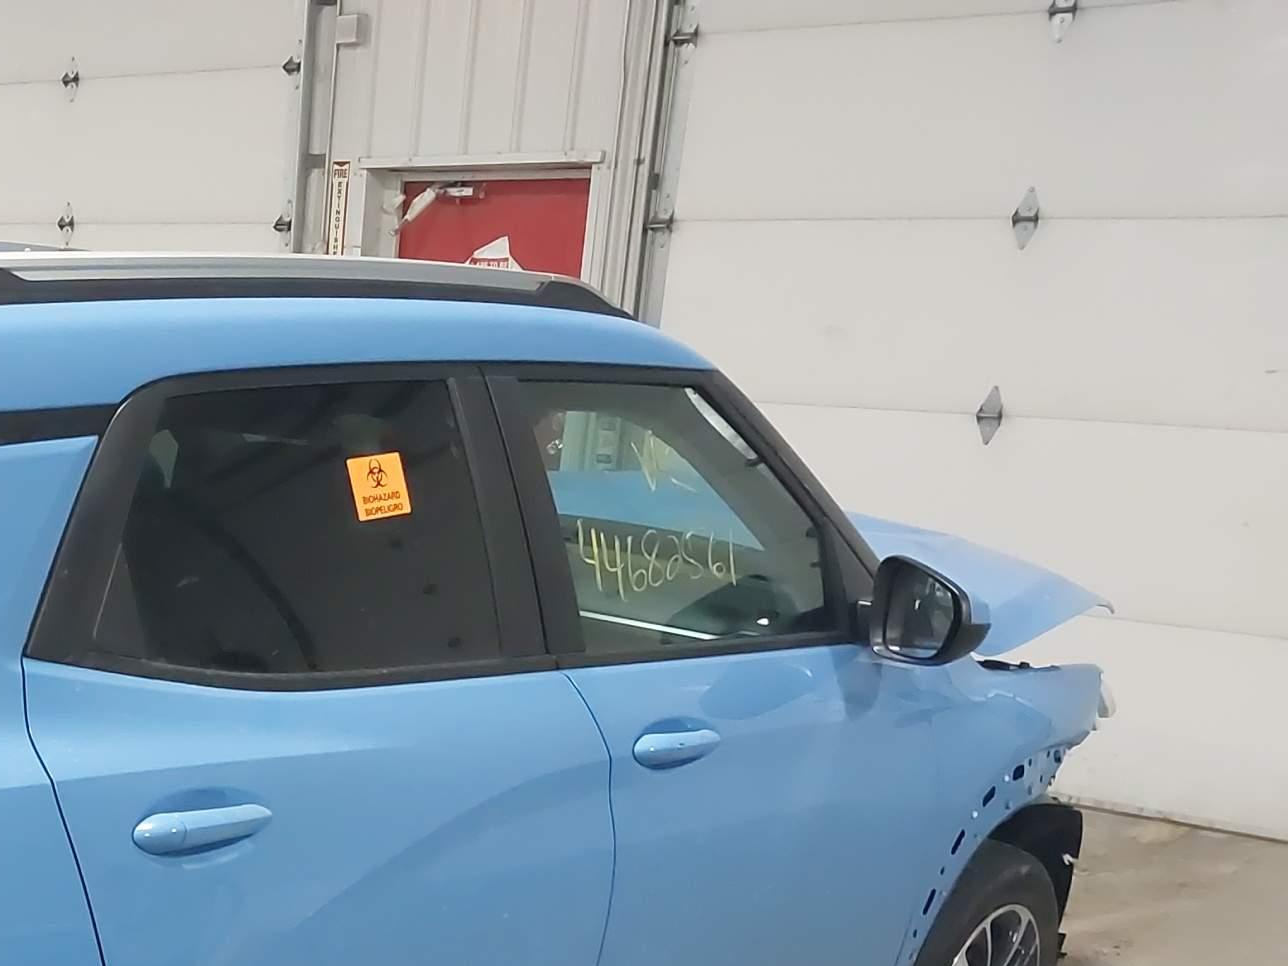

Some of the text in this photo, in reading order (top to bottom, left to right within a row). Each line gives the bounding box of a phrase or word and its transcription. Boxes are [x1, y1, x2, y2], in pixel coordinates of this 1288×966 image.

[334, 168, 347, 178] FIRE
[362, 491, 400, 505] BIOHAZARD
[364, 503, 403, 517] BIOPELIGRO
[577, 518, 737, 602] 44682561
